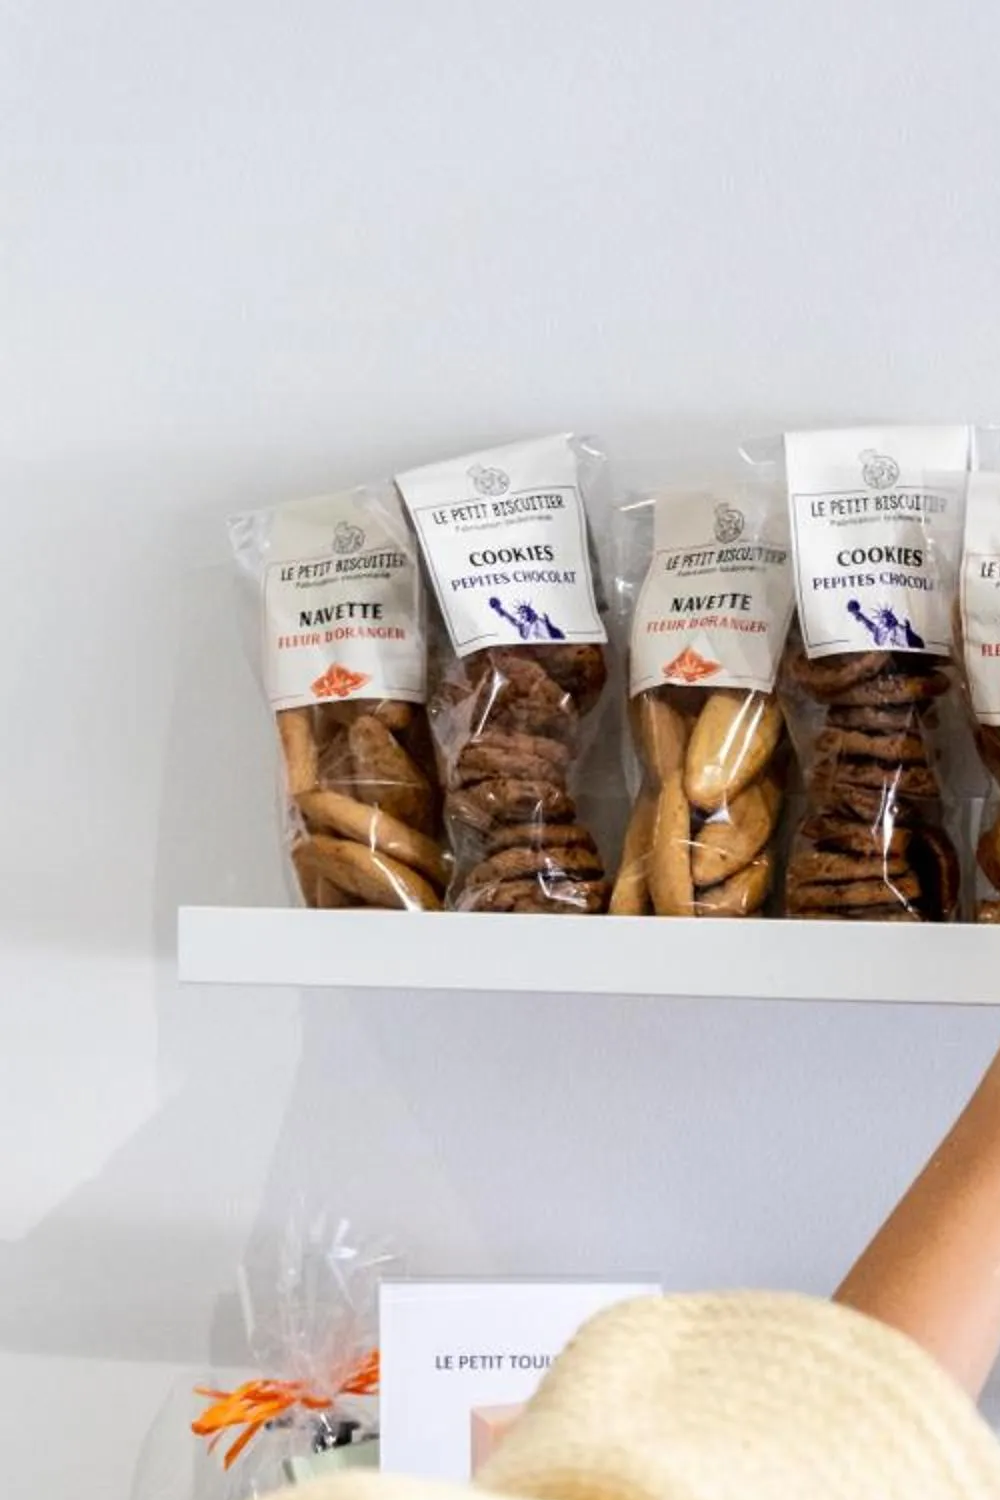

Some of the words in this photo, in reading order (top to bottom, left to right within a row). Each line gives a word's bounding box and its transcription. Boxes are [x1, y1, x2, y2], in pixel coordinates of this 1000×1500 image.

[432, 511, 449, 525] LE
[451, 503, 488, 522] PETIT
[492, 494, 565, 518] BISCUITIER
[811, 501, 827, 518] LE
[830, 497, 870, 516] PETIT
[468, 545, 555, 567] COOKIES
[665, 555, 679, 571] LE
[681, 551, 715, 567] PETIT
[836, 546, 924, 567] COOKIES
[281, 567, 294, 582] LE
[298, 560, 332, 579] PETIT
[980, 561, 994, 578] LE
[451, 571, 511, 592] PEPITES
[513, 570, 577, 585] CHOCOLAT
[812, 573, 876, 591] PEPITES
[671, 593, 752, 613] NAVETTE
[299, 602, 384, 628] NAVETTE
[646, 618, 686, 634] FLEUR
[278, 633, 321, 649] FLEUR
[435, 1355, 453, 1369] LE
[459, 1355, 503, 1370] PETIT
